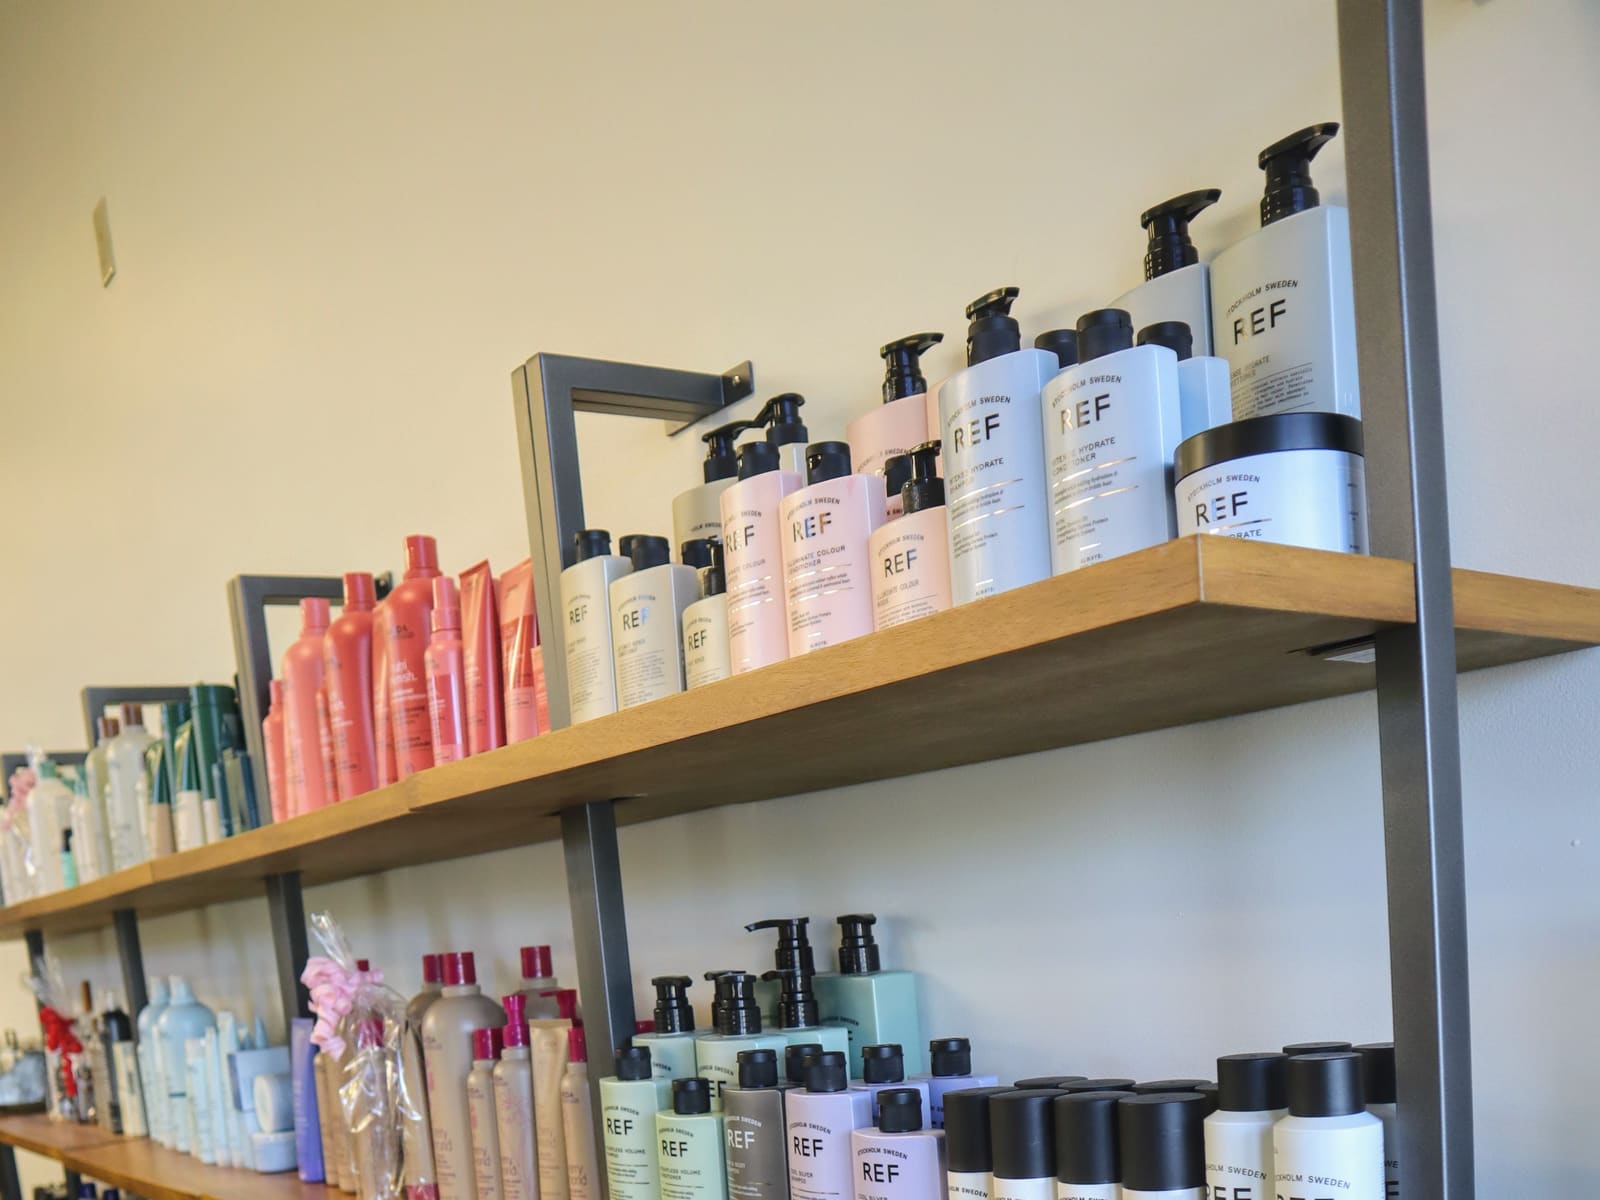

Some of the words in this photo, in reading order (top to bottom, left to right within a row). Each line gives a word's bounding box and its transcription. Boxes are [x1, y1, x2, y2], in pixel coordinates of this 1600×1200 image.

[1265, 279, 1298, 292] SWEDEN
[1233, 299, 1287, 345] REF
[1089, 375, 1122, 385] SWEDEN
[979, 396, 1011, 405] SWEDEN
[1060, 394, 1111, 434] REF
[954, 413, 1000, 454] REF
[1079, 437, 1116, 455] HYDRATE
[1226, 474, 1260, 483] SWEDEN
[815, 497, 840, 505] SWEDEN
[1195, 491, 1248, 527] REF
[792, 512, 832, 543] REF
[726, 525, 755, 554] REF
[816, 545, 846, 557] COLOUR
[884, 548, 918, 578] REF
[569, 605, 588, 625] REF
[623, 607, 651, 631] REF
[687, 629, 708, 651] REF
[709, 1080, 727, 1098] EF
[606, 1118, 634, 1136] REF
[662, 1139, 689, 1158] REF
[727, 1129, 755, 1149] REF
[793, 1136, 824, 1158] REF
[883, 1148, 908, 1160] SWEDEN
[862, 1162, 900, 1183] REF
[1227, 1166, 1267, 1180] SWEDEN
[1308, 1175, 1351, 1190] SWEDEN
[962, 1187, 988, 1198] SWEDEN
